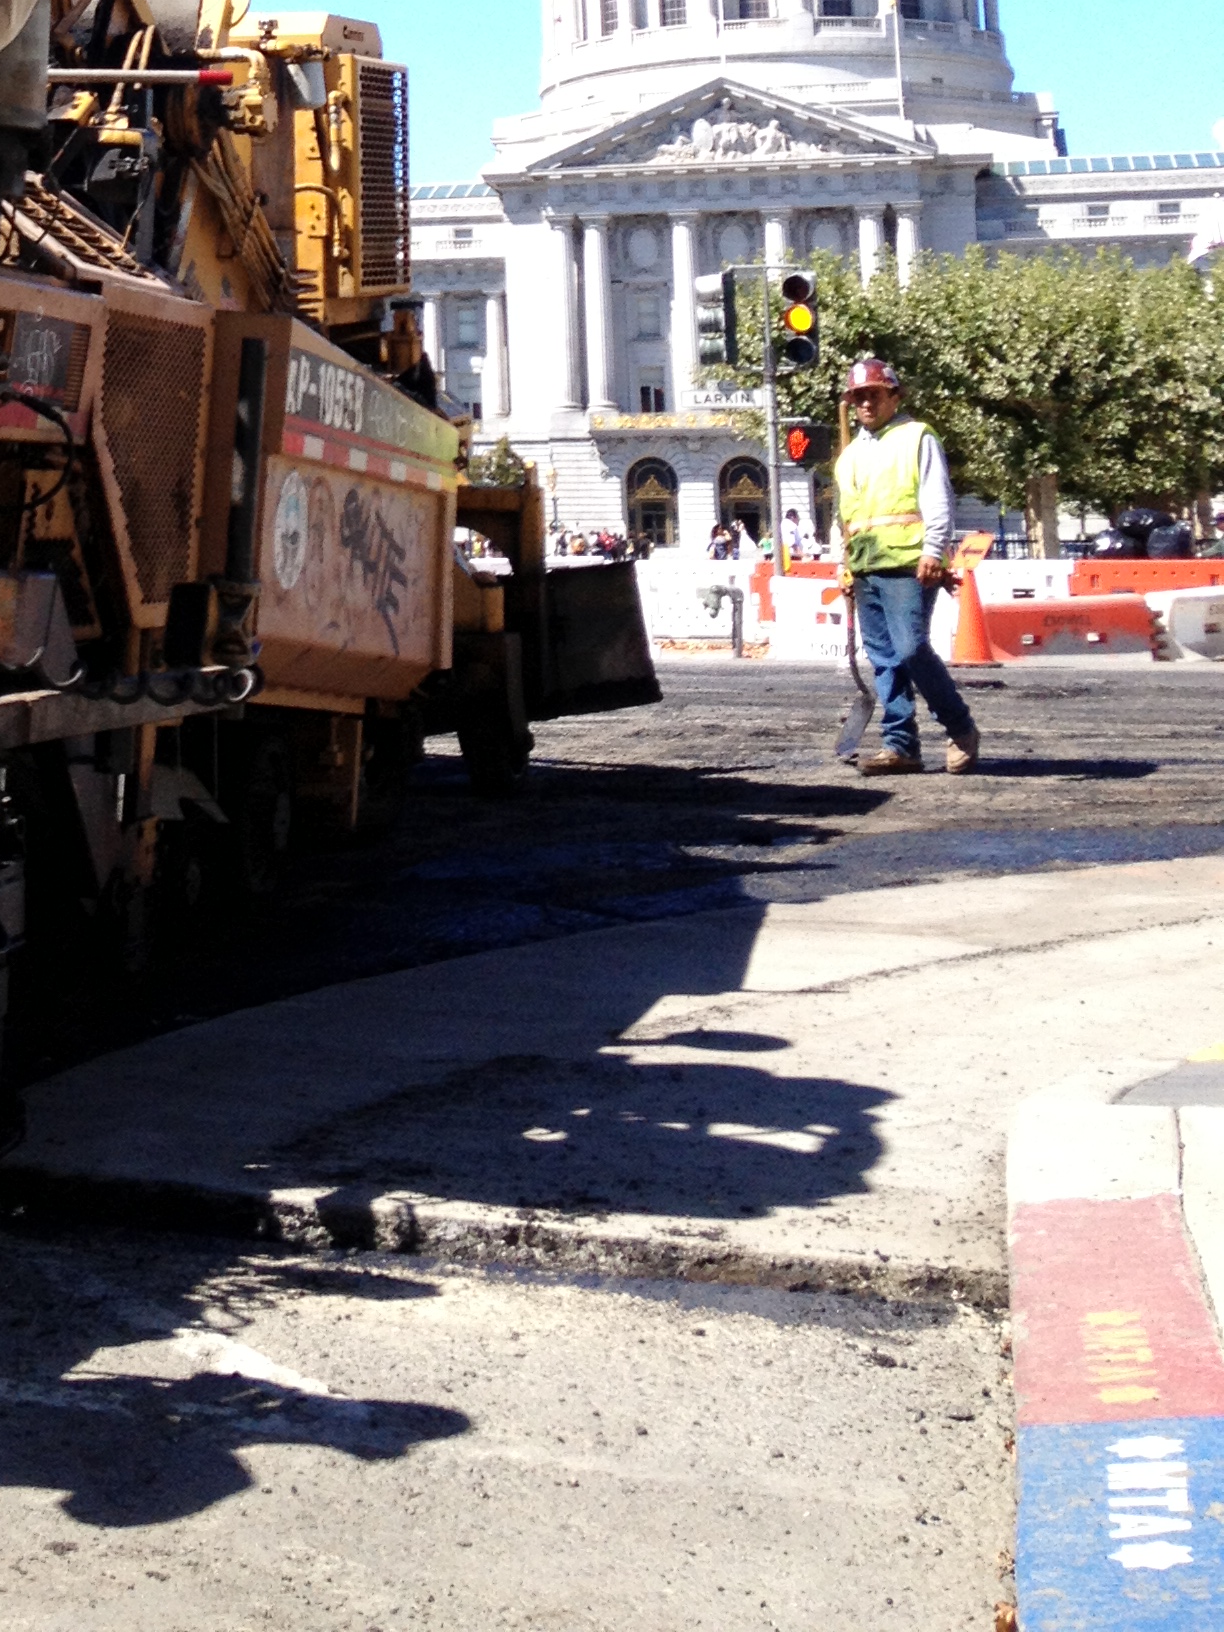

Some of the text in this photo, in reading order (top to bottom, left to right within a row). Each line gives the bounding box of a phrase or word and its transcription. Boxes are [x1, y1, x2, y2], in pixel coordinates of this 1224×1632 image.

[694, 393, 750, 404] LARKIN
[1083, 1327, 1157, 1384] MTA
[1106, 1461, 1192, 1538] MTA
